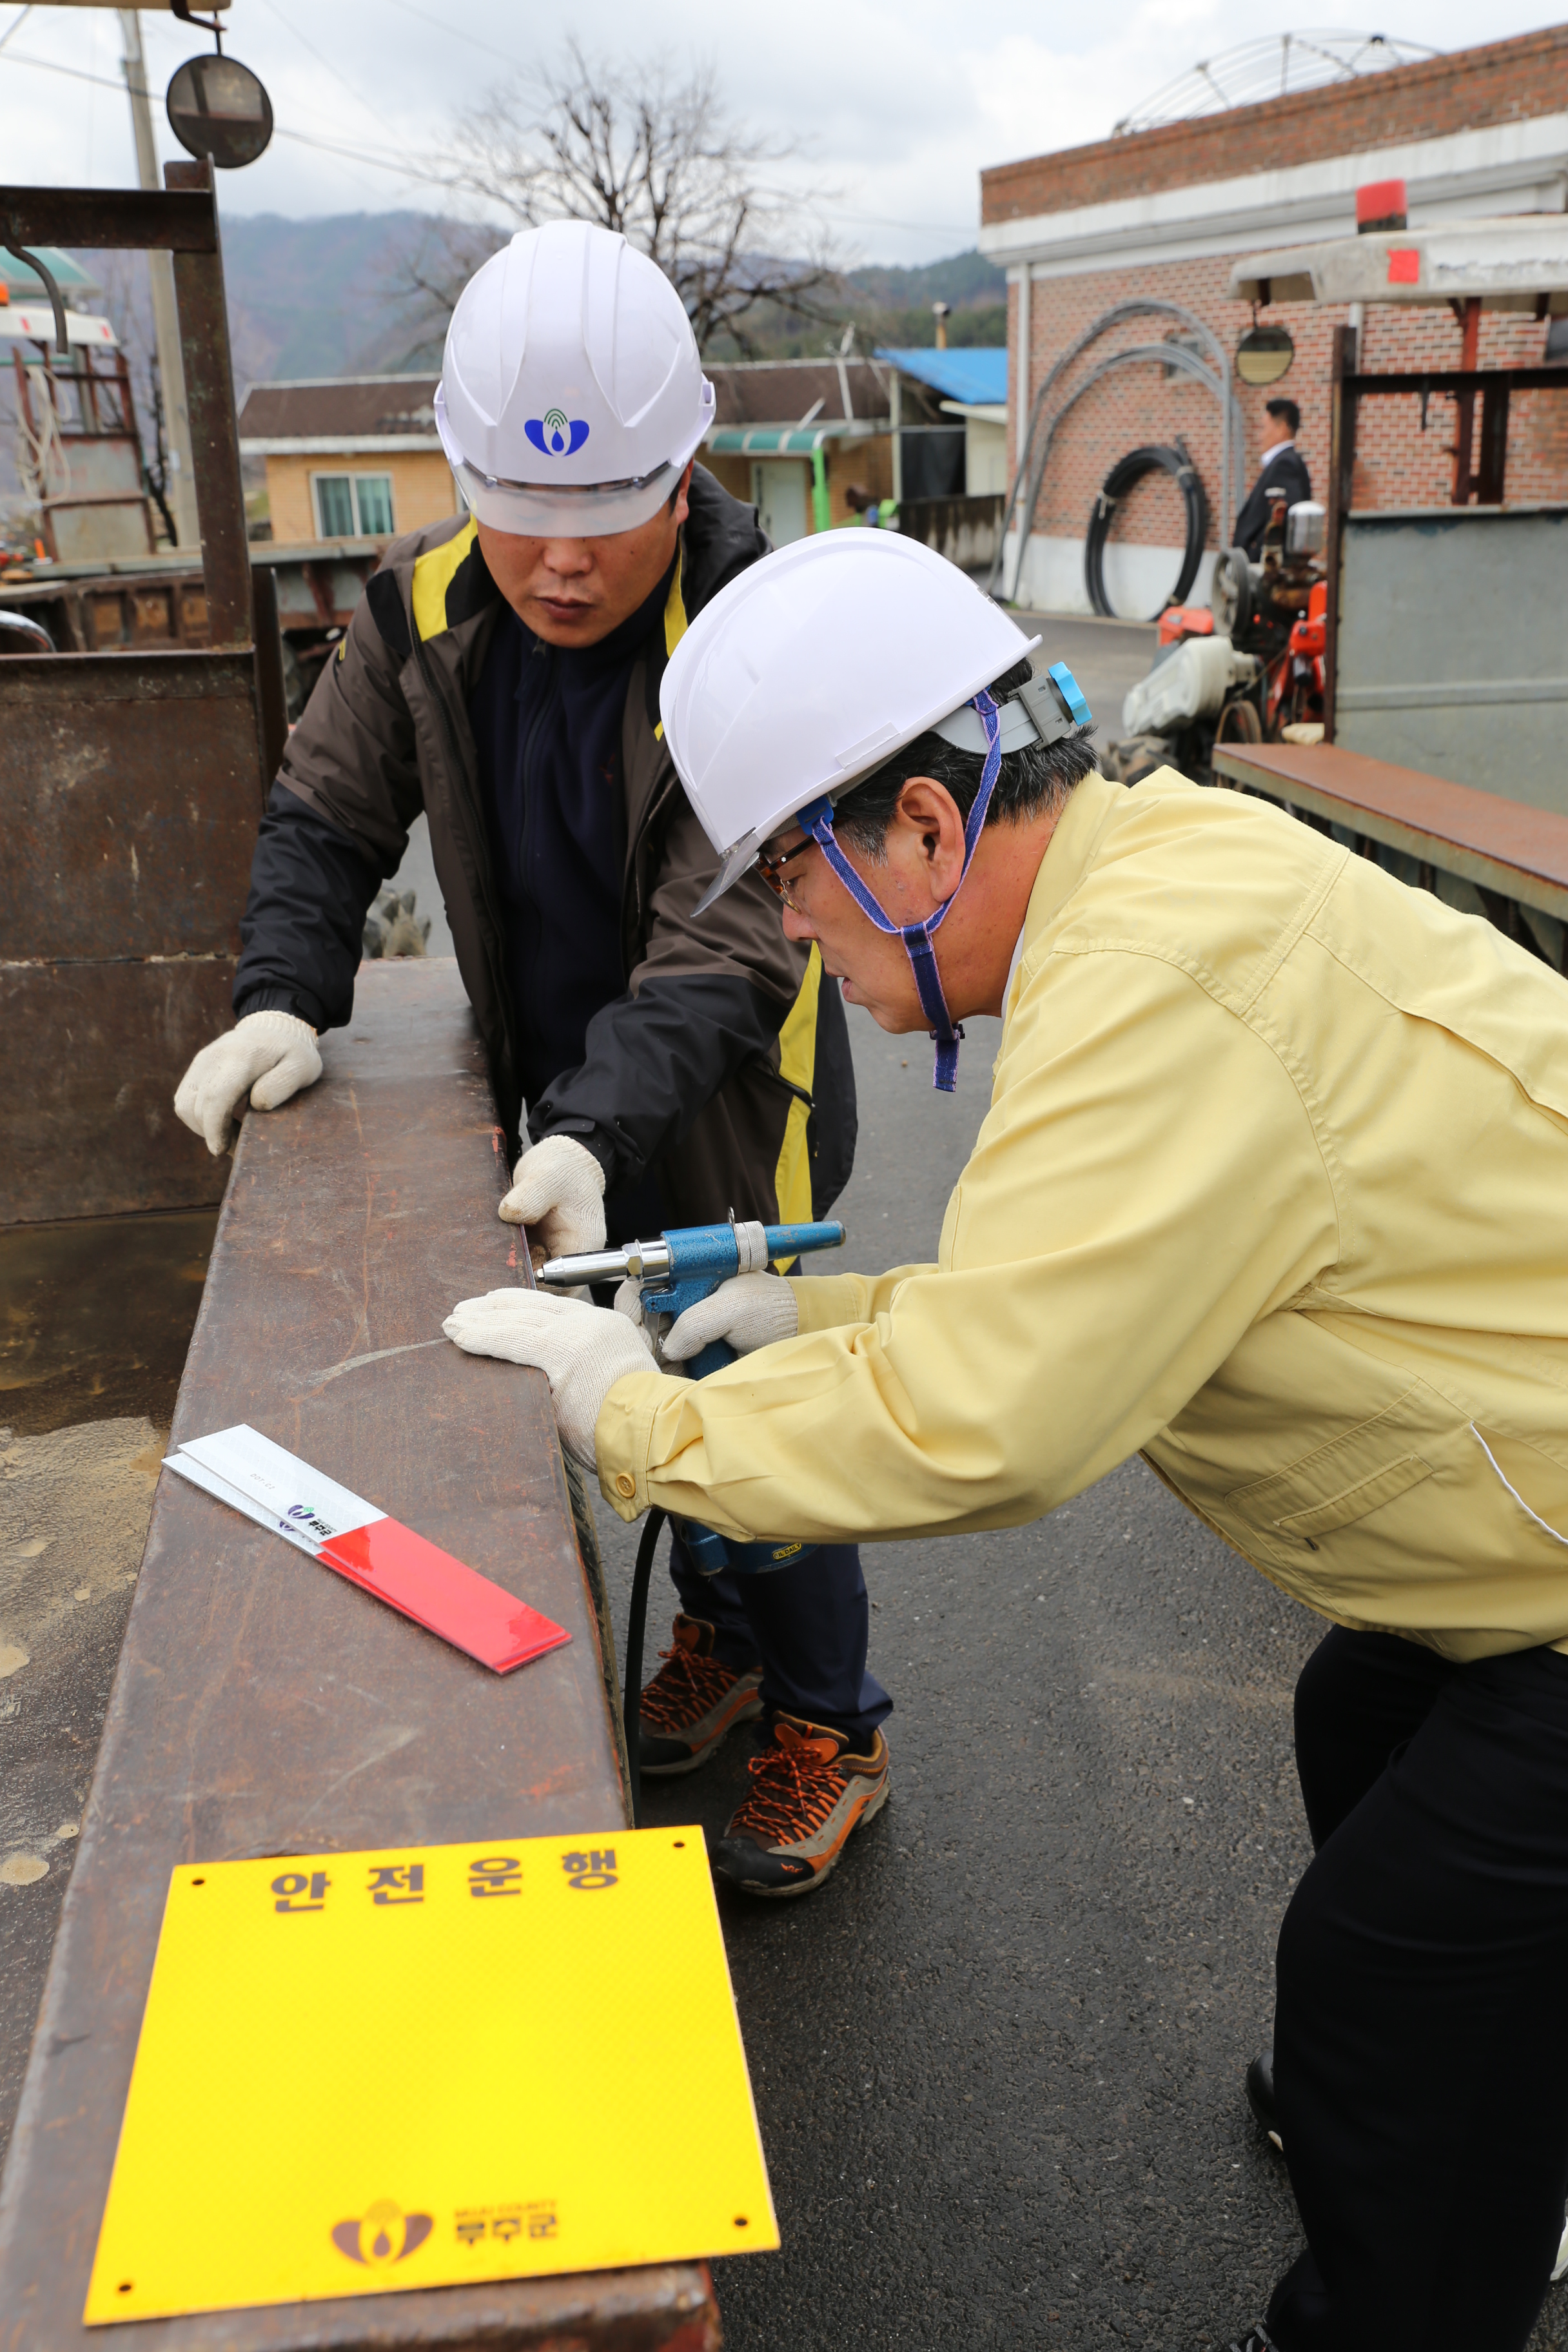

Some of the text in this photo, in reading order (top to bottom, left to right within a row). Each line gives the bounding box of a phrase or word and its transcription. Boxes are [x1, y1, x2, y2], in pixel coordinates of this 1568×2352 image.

[308, 1520, 332, 1536] 무주군
[785, 1543, 801, 1554] DAILY
[456, 2215, 557, 2245] 무주군
